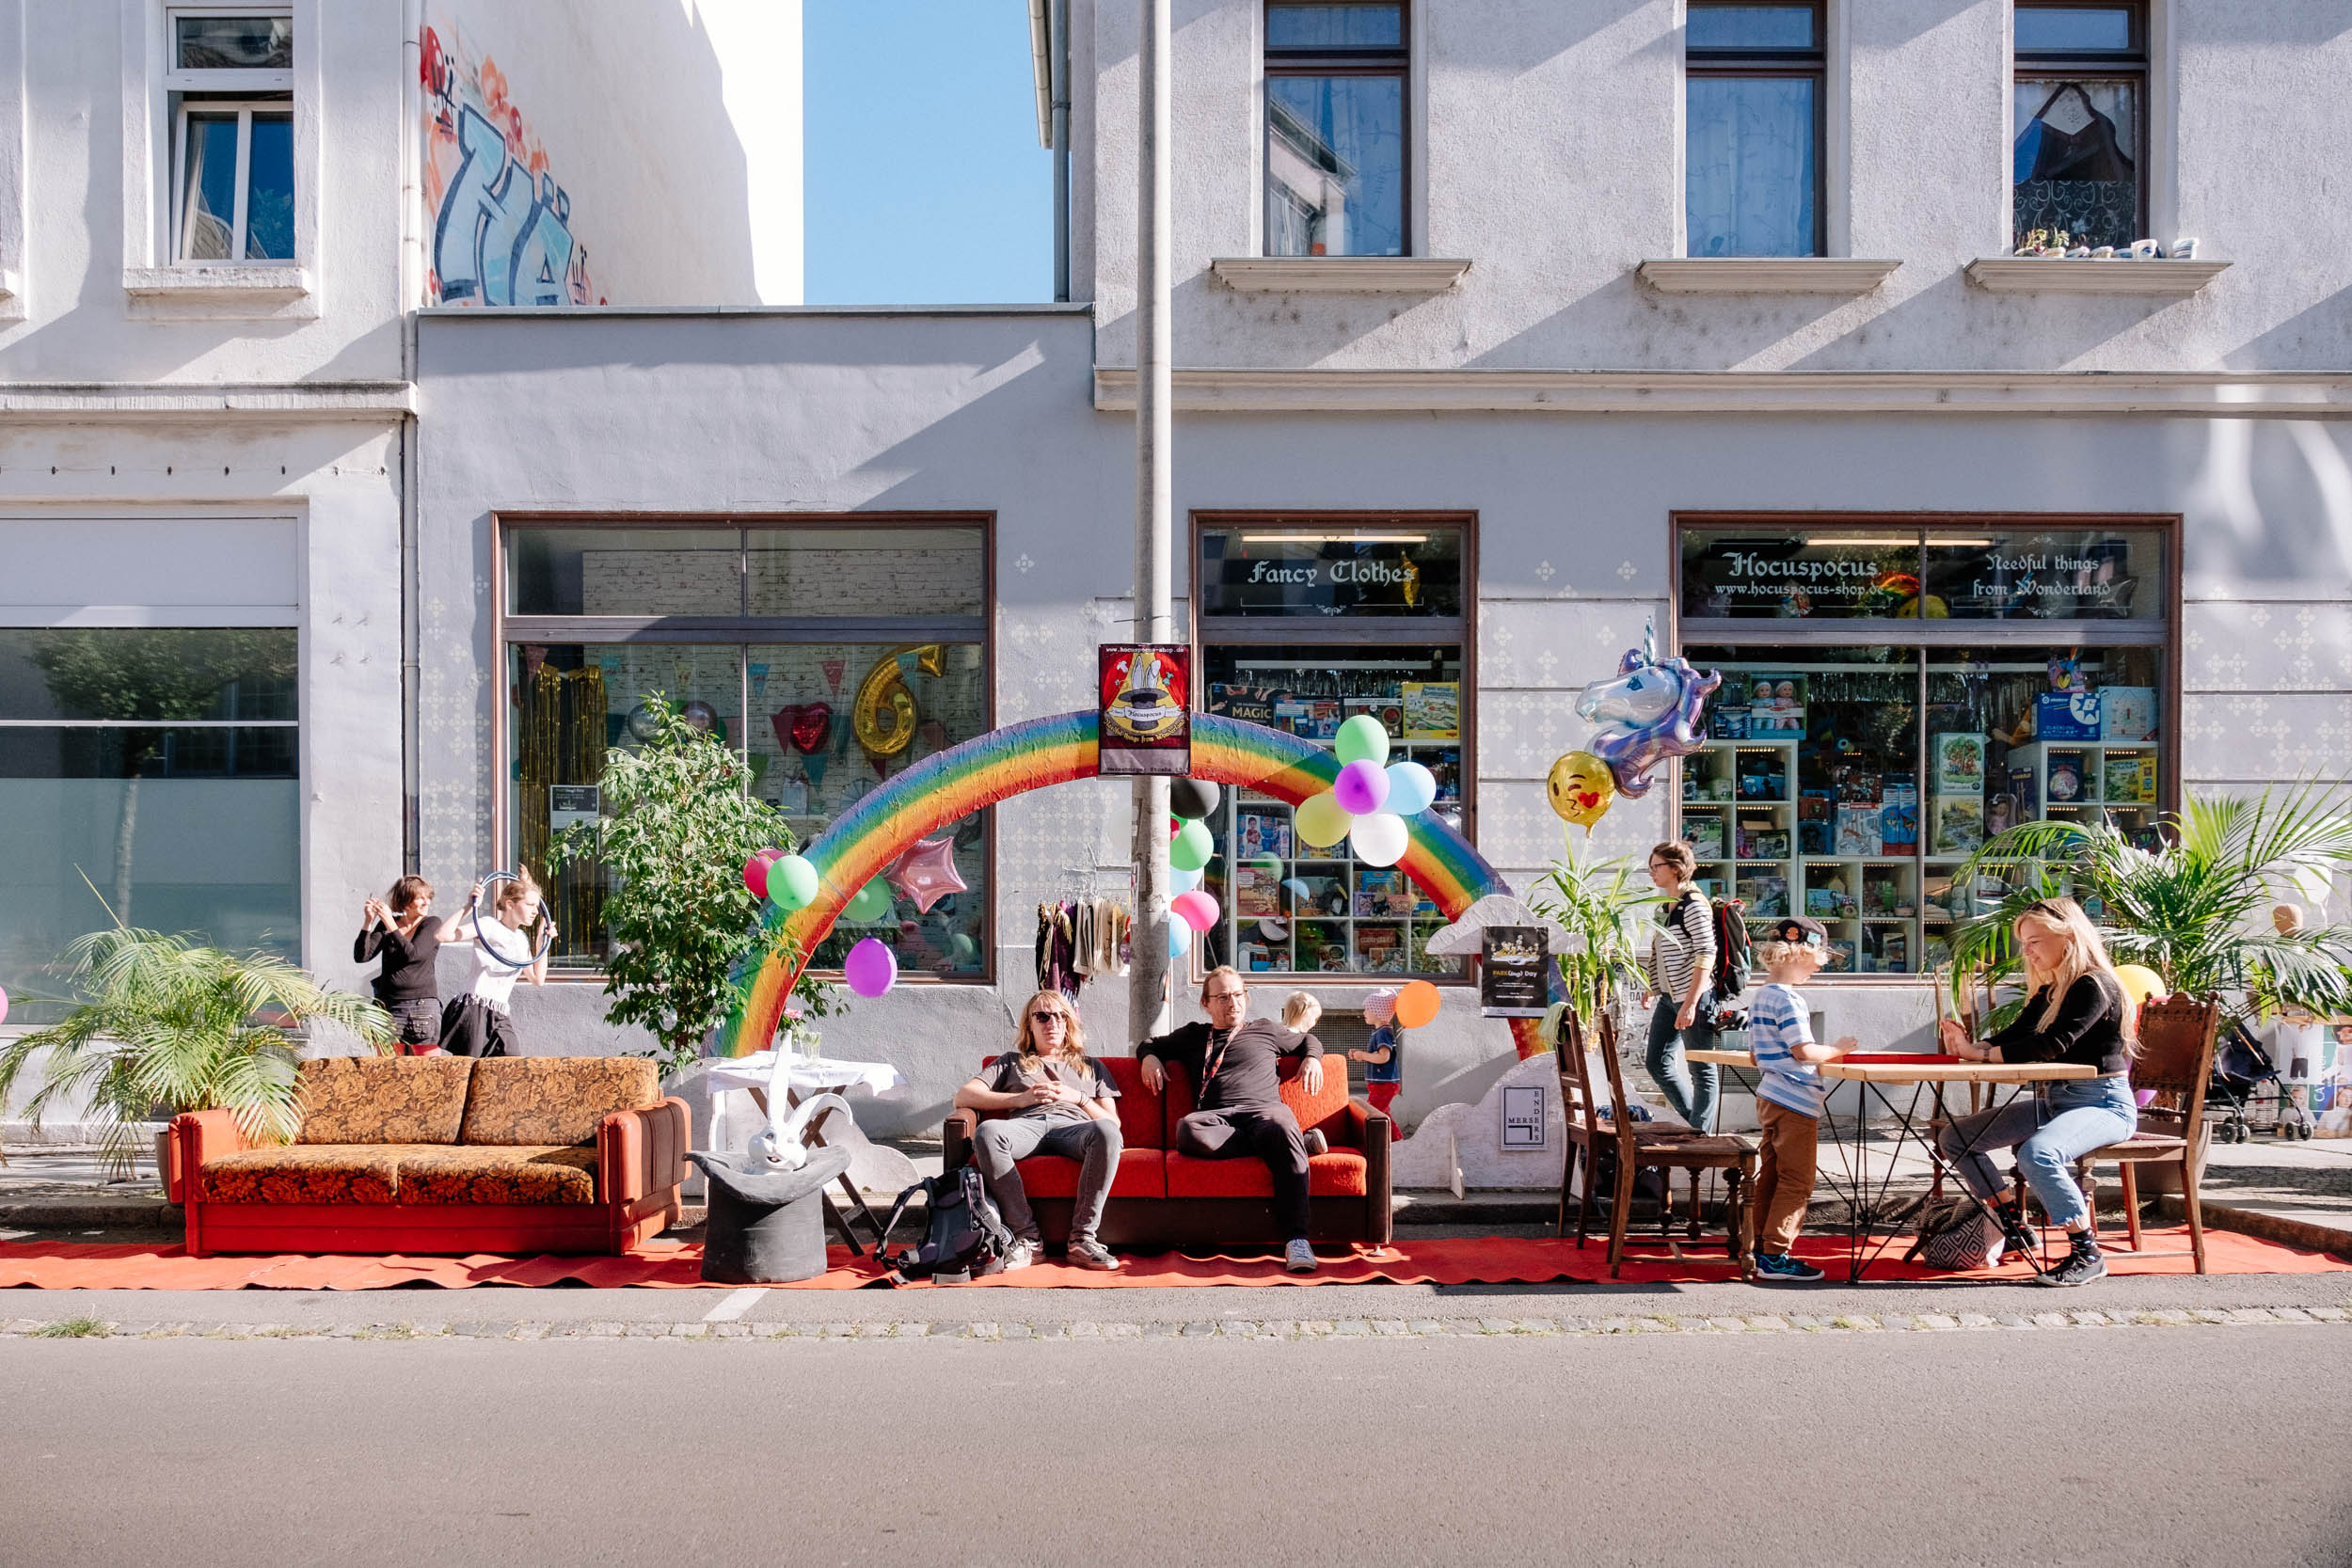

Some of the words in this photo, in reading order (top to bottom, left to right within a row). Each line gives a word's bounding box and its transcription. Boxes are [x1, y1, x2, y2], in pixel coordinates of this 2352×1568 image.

[1248, 561, 1318, 587] Fancy
[1329, 561, 1415, 587] Clothes
[1722, 551, 1878, 582] Hocuspocus
[1985, 554, 2047, 574] Needful
[2055, 554, 2100, 573] things
[1715, 580, 1884, 599] www.hocuspocus-shop.de
[1973, 578, 2009, 598] from
[2015, 579, 2111, 597] Wonderland
[1232, 706, 1273, 719] MAGIC
